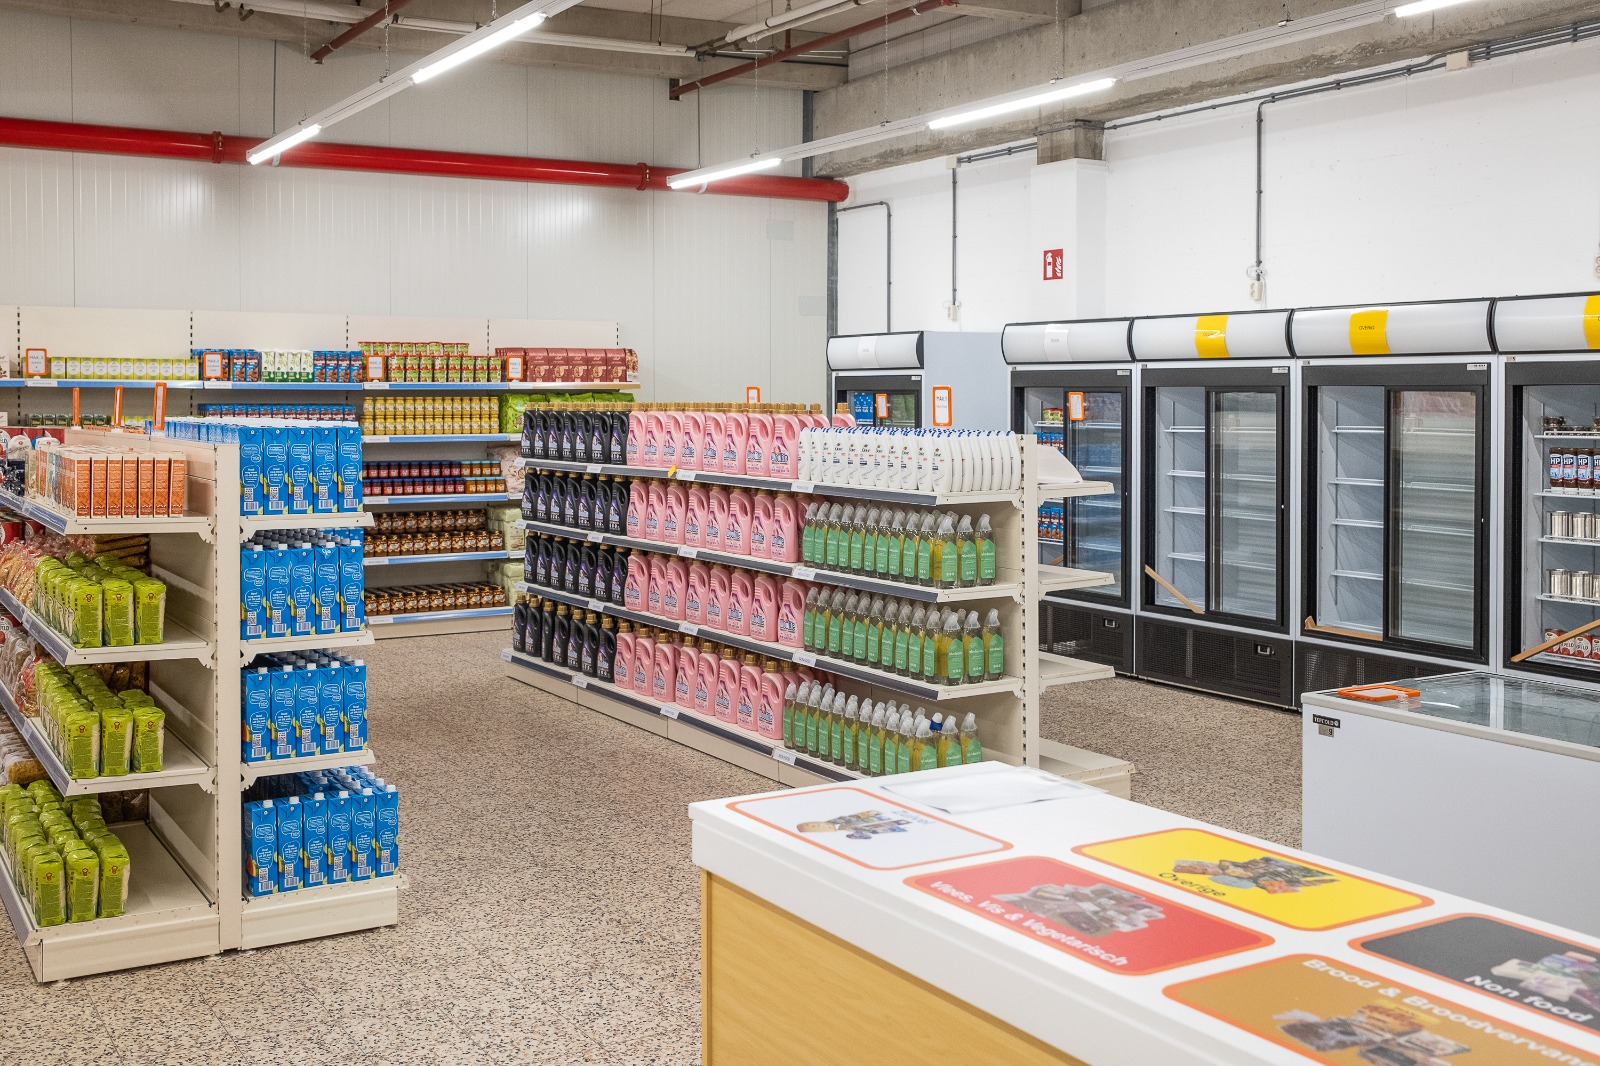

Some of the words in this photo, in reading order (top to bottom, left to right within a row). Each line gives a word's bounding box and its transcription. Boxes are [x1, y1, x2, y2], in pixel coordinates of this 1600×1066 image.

[1550, 457, 1561, 465] HP
[1578, 458, 1588, 466] HP
[1158, 872, 1227, 897] Overige
[977, 900, 1006, 915] Vis
[1003, 912, 1025, 922] &
[1022, 918, 1129, 967] Vegetarisch
[1302, 958, 1382, 990] Brood
[1377, 983, 1402, 998] &
[1401, 994, 1600, 1066] Broodvervan
[1464, 974, 1519, 999] Non
[1523, 994, 1595, 1023] food
